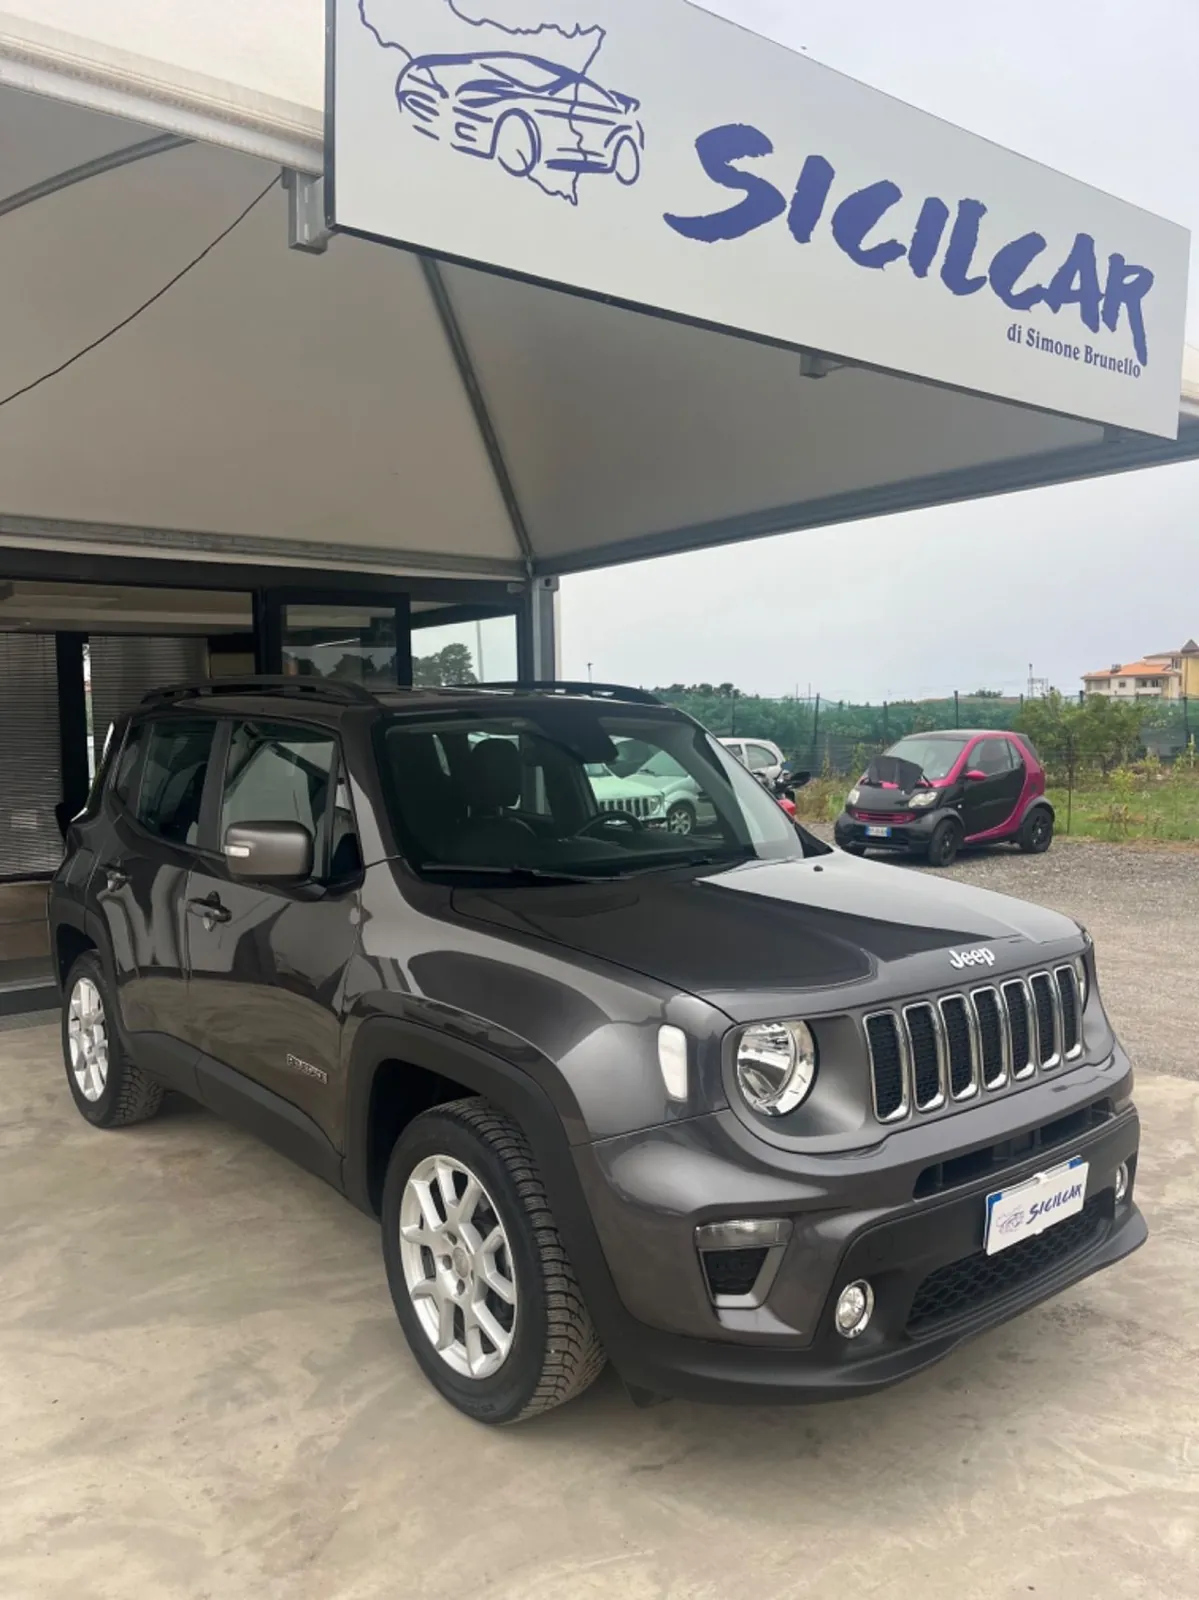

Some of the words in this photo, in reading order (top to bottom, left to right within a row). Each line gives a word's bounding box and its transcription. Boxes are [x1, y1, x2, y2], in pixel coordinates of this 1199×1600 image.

[662, 122, 1155, 366] SICILCAR
[1006, 323, 1023, 344] di
[1025, 327, 1081, 361] Simone
[1083, 344, 1141, 379] Brunello
[948, 947, 996, 969] Jeep
[1025, 1183, 1083, 1225] SICILCAR
